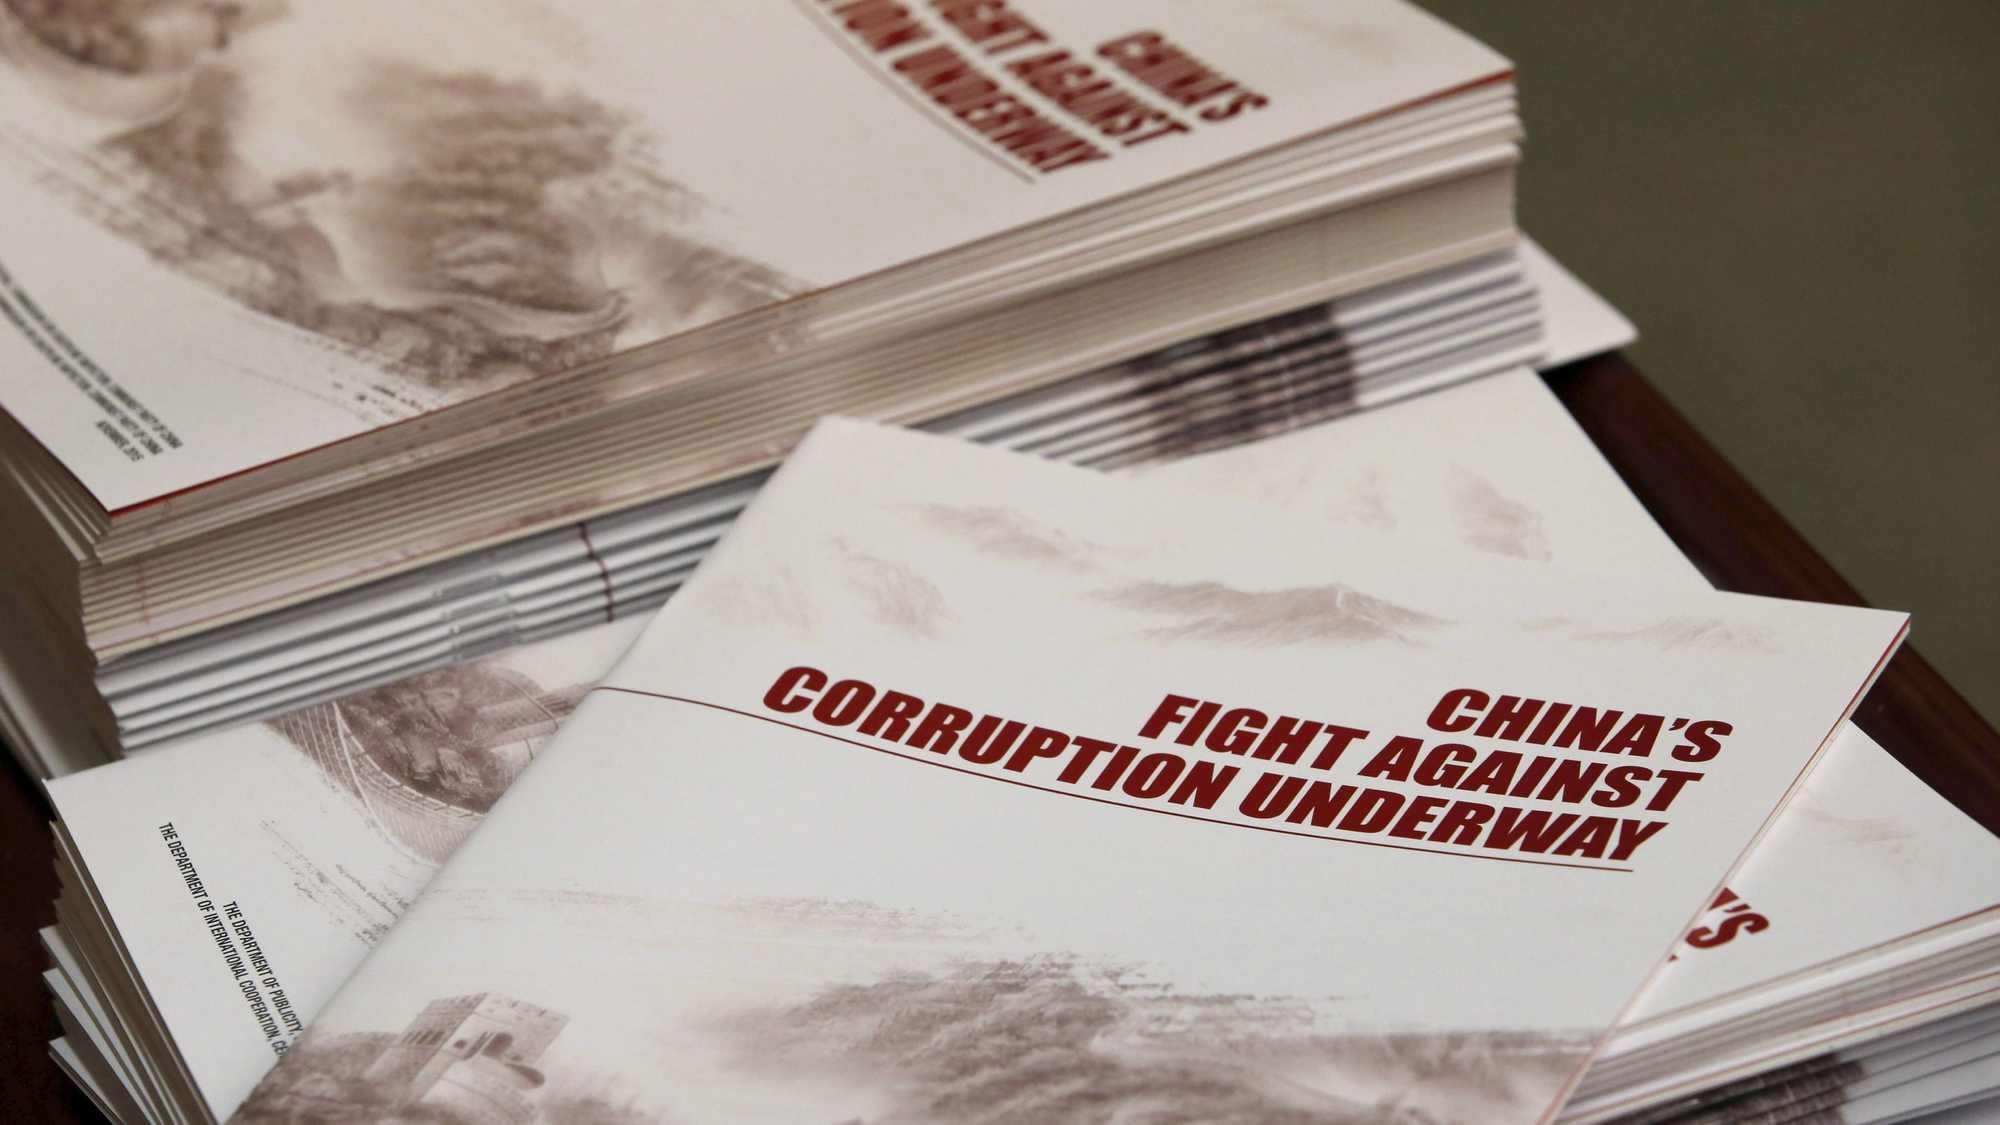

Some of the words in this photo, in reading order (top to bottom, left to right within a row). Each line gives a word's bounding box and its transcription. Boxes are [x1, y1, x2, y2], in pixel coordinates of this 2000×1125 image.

[1141, 694, 1369, 771] FIGHT
[1360, 736, 1703, 811] AGAINST
[1428, 688, 1732, 762] CHINA'S
[763, 666, 1239, 810] CORRUPTION
[1240, 773, 1668, 861] UNDERWAY
[159, 822, 178, 841] THE
[167, 841, 208, 899] DEPARTMENT
[197, 900, 215, 911] OF
[223, 901, 243, 920] THE
[203, 913, 248, 981] INTERNATIONAL
[232, 919, 273, 976] DEPARTMENT
[239, 980, 281, 1042] COOPERATION,
[262, 977, 280, 988] OF
[269, 989, 304, 1036] PUBLICITY,
